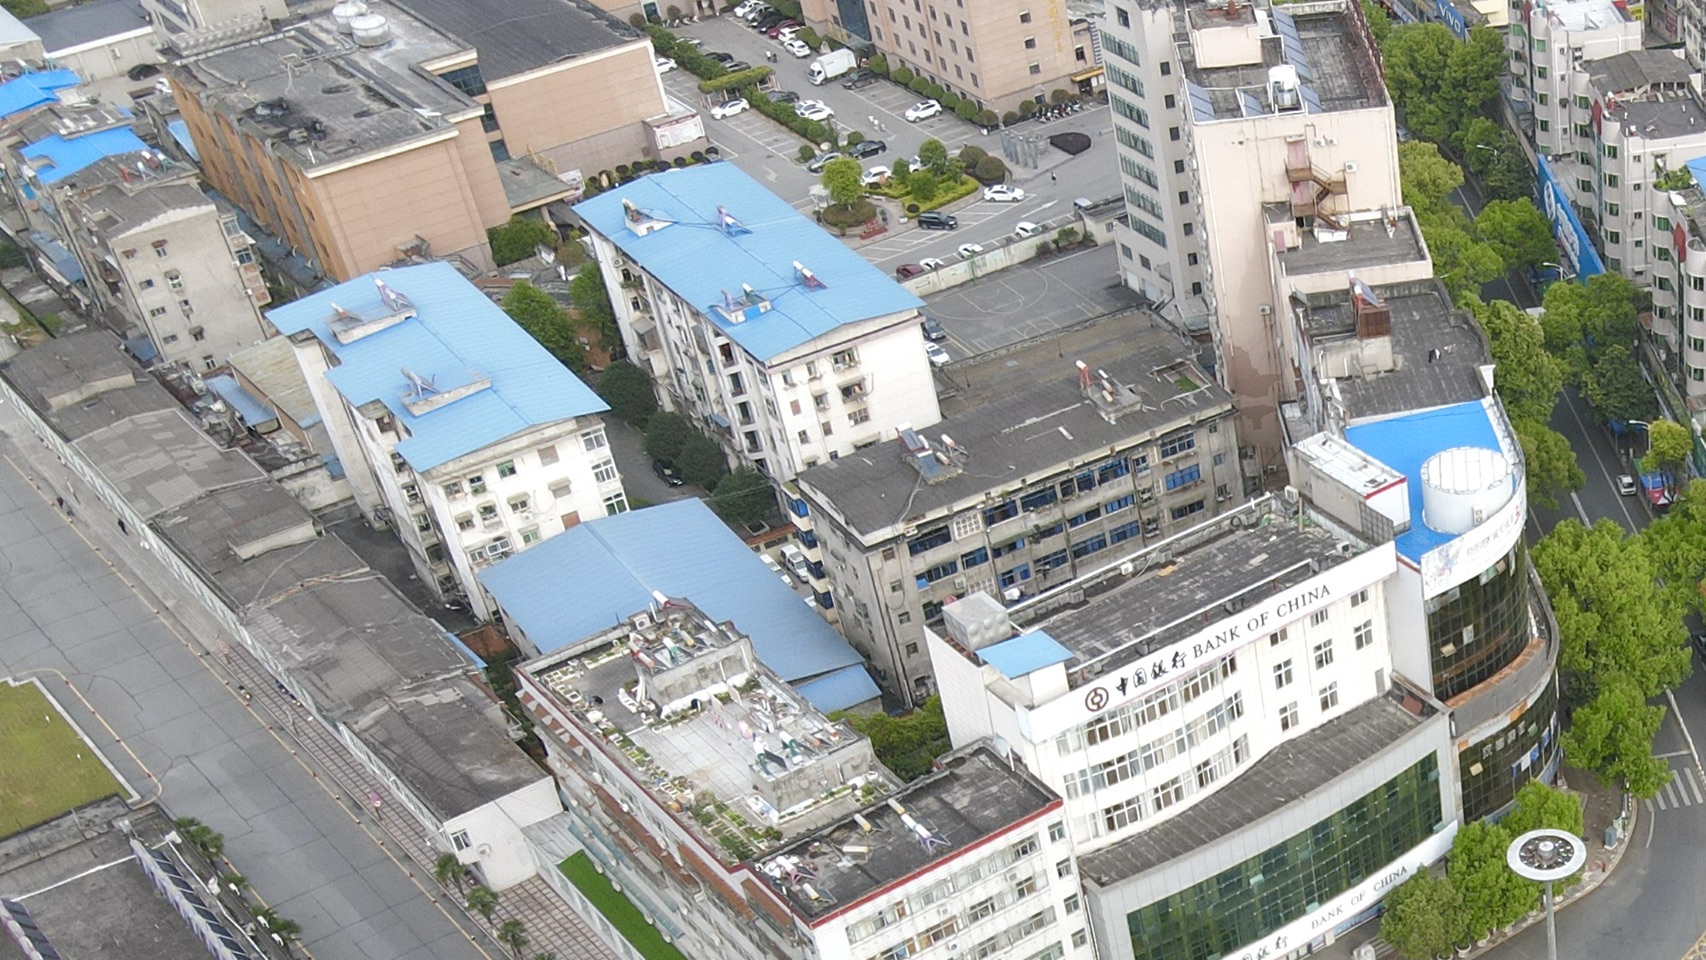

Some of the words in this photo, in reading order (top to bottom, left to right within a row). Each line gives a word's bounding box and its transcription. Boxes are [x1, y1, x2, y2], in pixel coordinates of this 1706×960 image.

[1115, 651, 1188, 697] 中国银行
[1192, 625, 1241, 659] BANK
[1247, 611, 1270, 632] OF
[1276, 584, 1332, 618] CHINA
[1311, 904, 1344, 930] BANK
[1350, 890, 1366, 906] OF
[1373, 865, 1408, 892] CHINA
